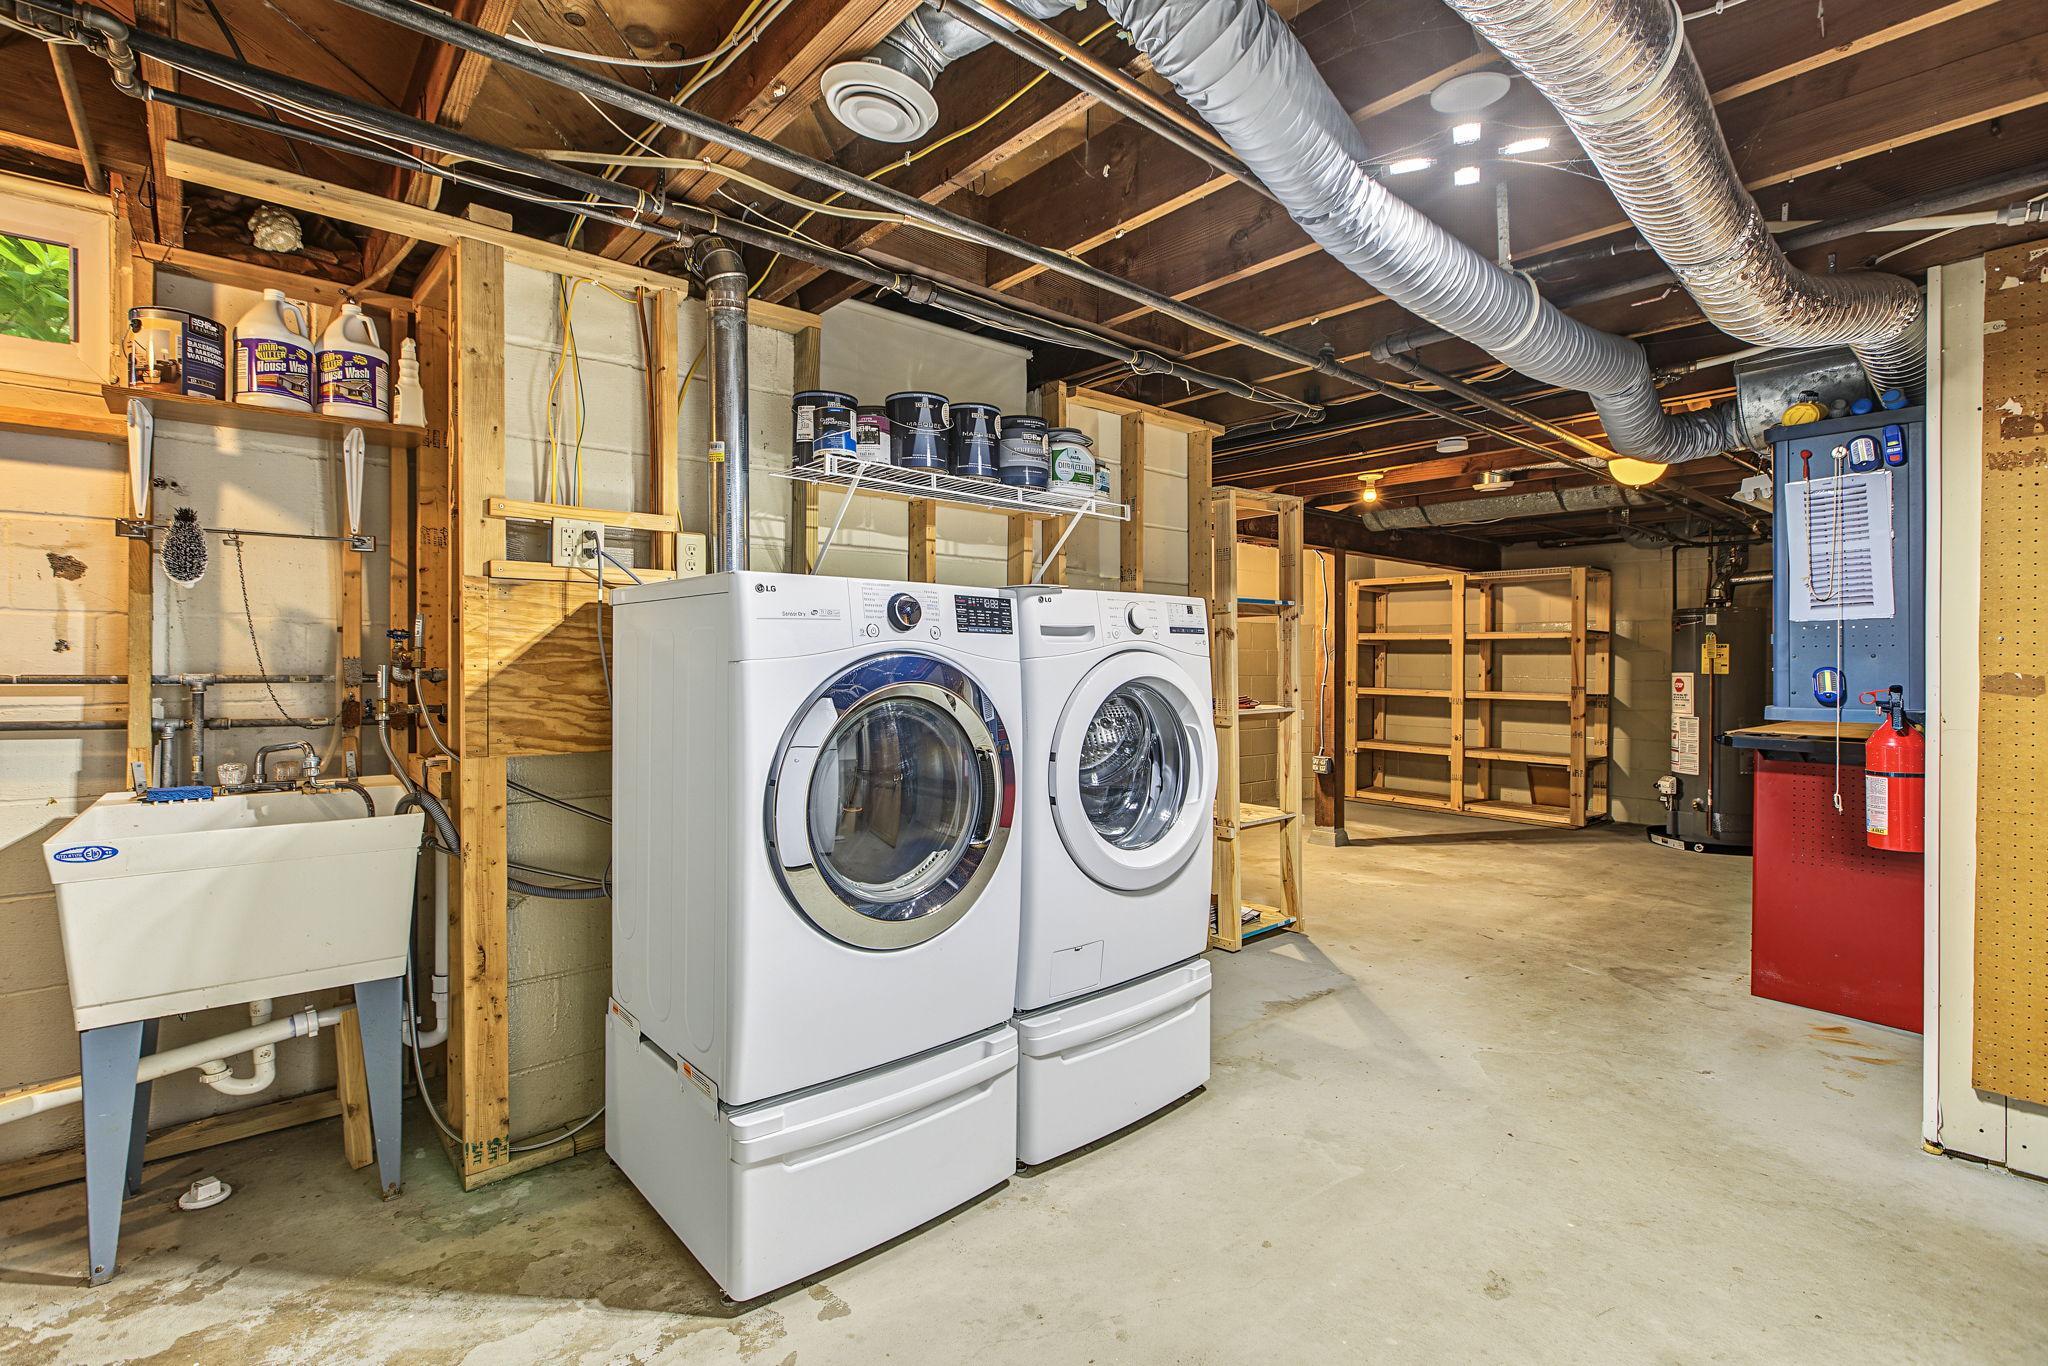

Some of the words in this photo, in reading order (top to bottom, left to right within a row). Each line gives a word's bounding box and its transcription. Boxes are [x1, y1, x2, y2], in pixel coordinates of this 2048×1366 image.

[257, 361, 287, 372] House
[289, 361, 308, 374] Wash
[320, 370, 343, 383] House
[344, 367, 370, 379] Wash
